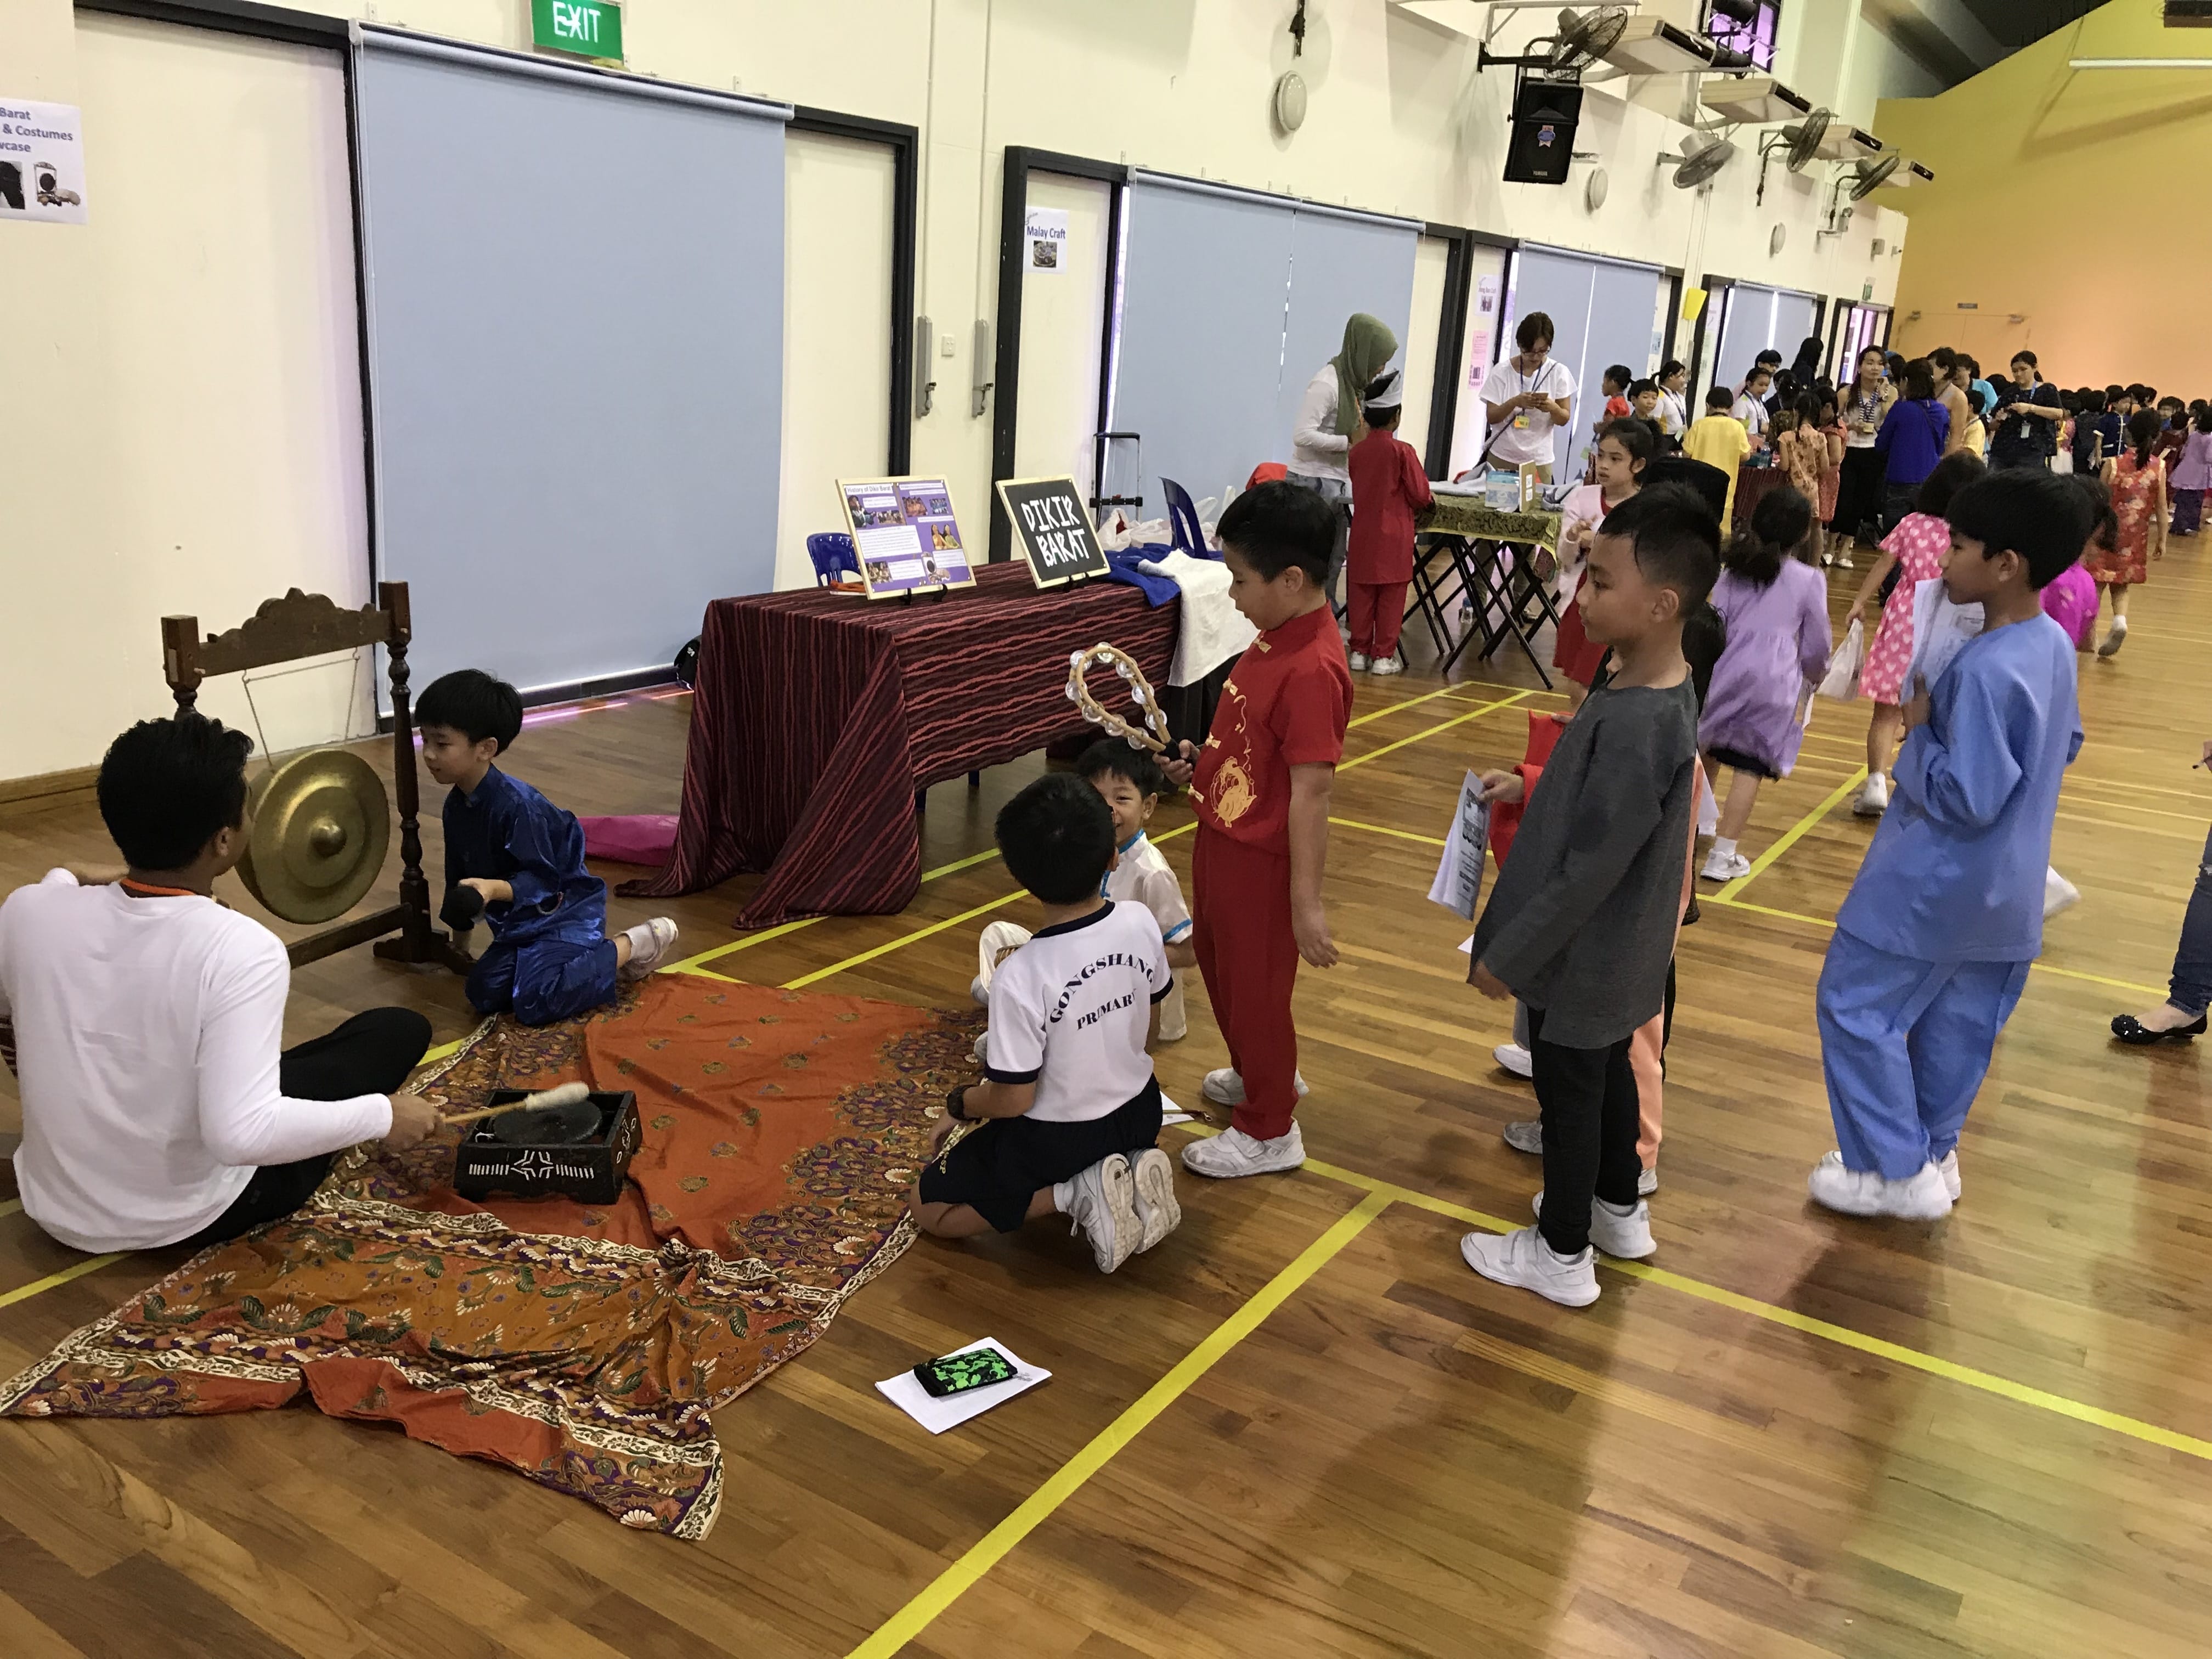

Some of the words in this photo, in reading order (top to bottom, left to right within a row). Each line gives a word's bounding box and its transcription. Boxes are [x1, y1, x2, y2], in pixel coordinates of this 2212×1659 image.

[552, 1, 601, 43] EXIT
[0, 107, 31, 120] Barat
[3, 123, 13, 134] &
[15, 125, 73, 142] Costumes
[1027, 225, 1048, 240] Malay
[1049, 228, 1066, 240] Craft
[1021, 495, 1080, 532] DIKIR
[1036, 528, 1090, 567] BARAT
[1049, 953, 1154, 1023] GONGSHANG
